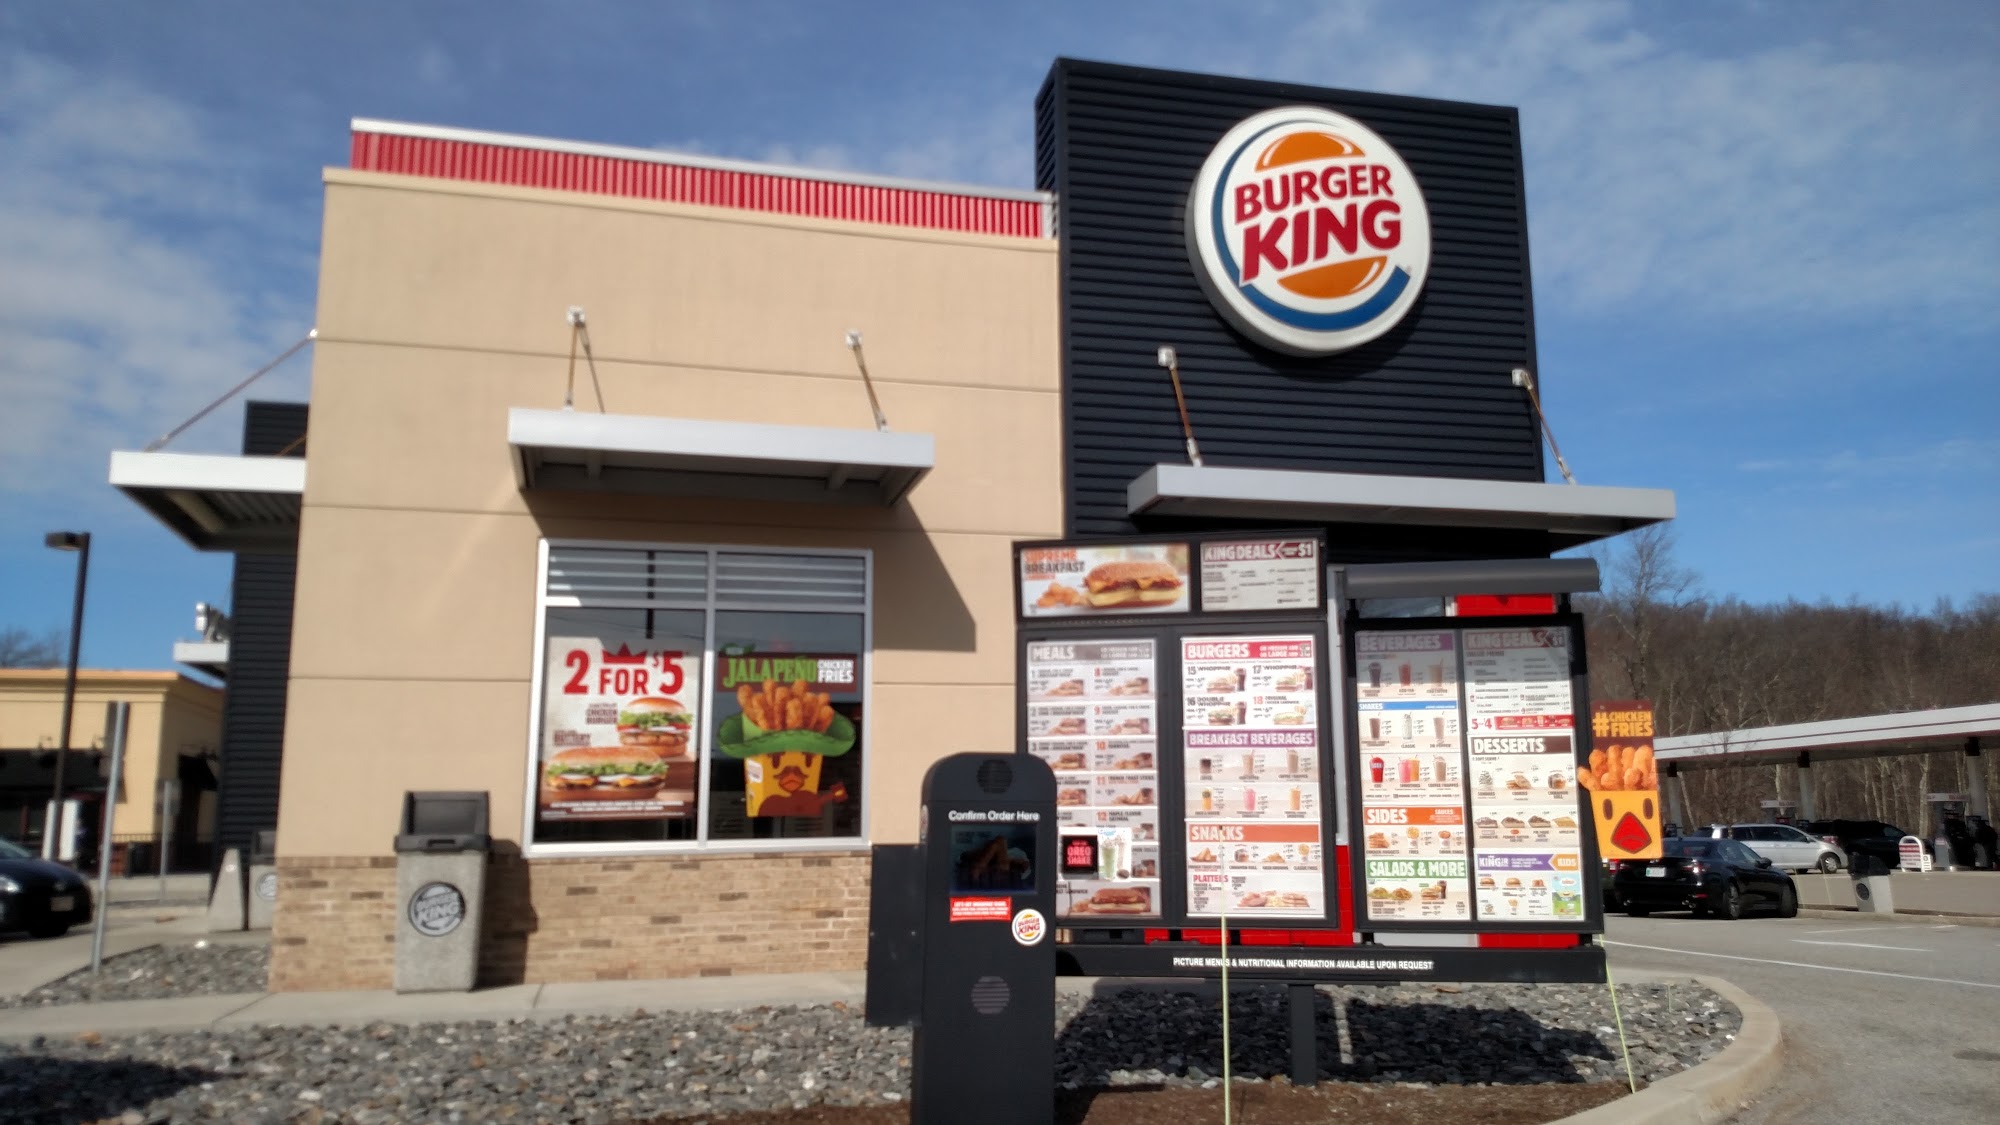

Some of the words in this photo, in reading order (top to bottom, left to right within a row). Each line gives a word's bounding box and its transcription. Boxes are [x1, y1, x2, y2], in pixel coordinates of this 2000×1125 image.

[1234, 164, 1393, 225] BURGER
[1242, 199, 1401, 283] KING
[1204, 546, 1236, 561] KING
[1236, 544, 1277, 560] DEALS
[1025, 561, 1084, 574] BREAKFAST
[1359, 635, 1442, 651] BEVERAGES
[1032, 646, 1075, 660] MEALS
[1187, 644, 1249, 659] BURGERS
[817, 659, 854, 670] CHICKEN
[1187, 666, 1197, 675] 15
[1252, 665, 1262, 674] 17
[563, 649, 589, 695] 2
[599, 668, 648, 695] FOR
[817, 670, 854, 684] FRIES
[1253, 696, 1263, 705] 18
[1609, 711, 1652, 722] CHICKEN
[1471, 718, 1479, 730] 5
[1610, 722, 1653, 737] FRIES
[1189, 733, 1249, 745] BREAKFAST
[1250, 733, 1313, 745] BEVERAGES
[1474, 738, 1545, 754] DESSERTS
[948, 810, 986, 821] Confirm
[987, 810, 1015, 821] Order
[1016, 811, 1040, 821] Here
[1367, 808, 1408, 824] SIDES
[1369, 861, 1415, 877] SALADS
[1417, 861, 1427, 877] &
[1428, 861, 1465, 877] MORE
[417, 903, 460, 924] KING
[1018, 924, 1041, 935] KING
[1173, 958, 1203, 966] PICTURE
[1231, 959, 1237, 967] &
[1238, 958, 1285, 968] NUTRITIONAL
[1286, 959, 1335, 968] INFORMATION
[1336, 960, 1375, 969] AVAILABLE
[1376, 960, 1397, 969] UPON
[1398, 961, 1434, 970] REQUEST
